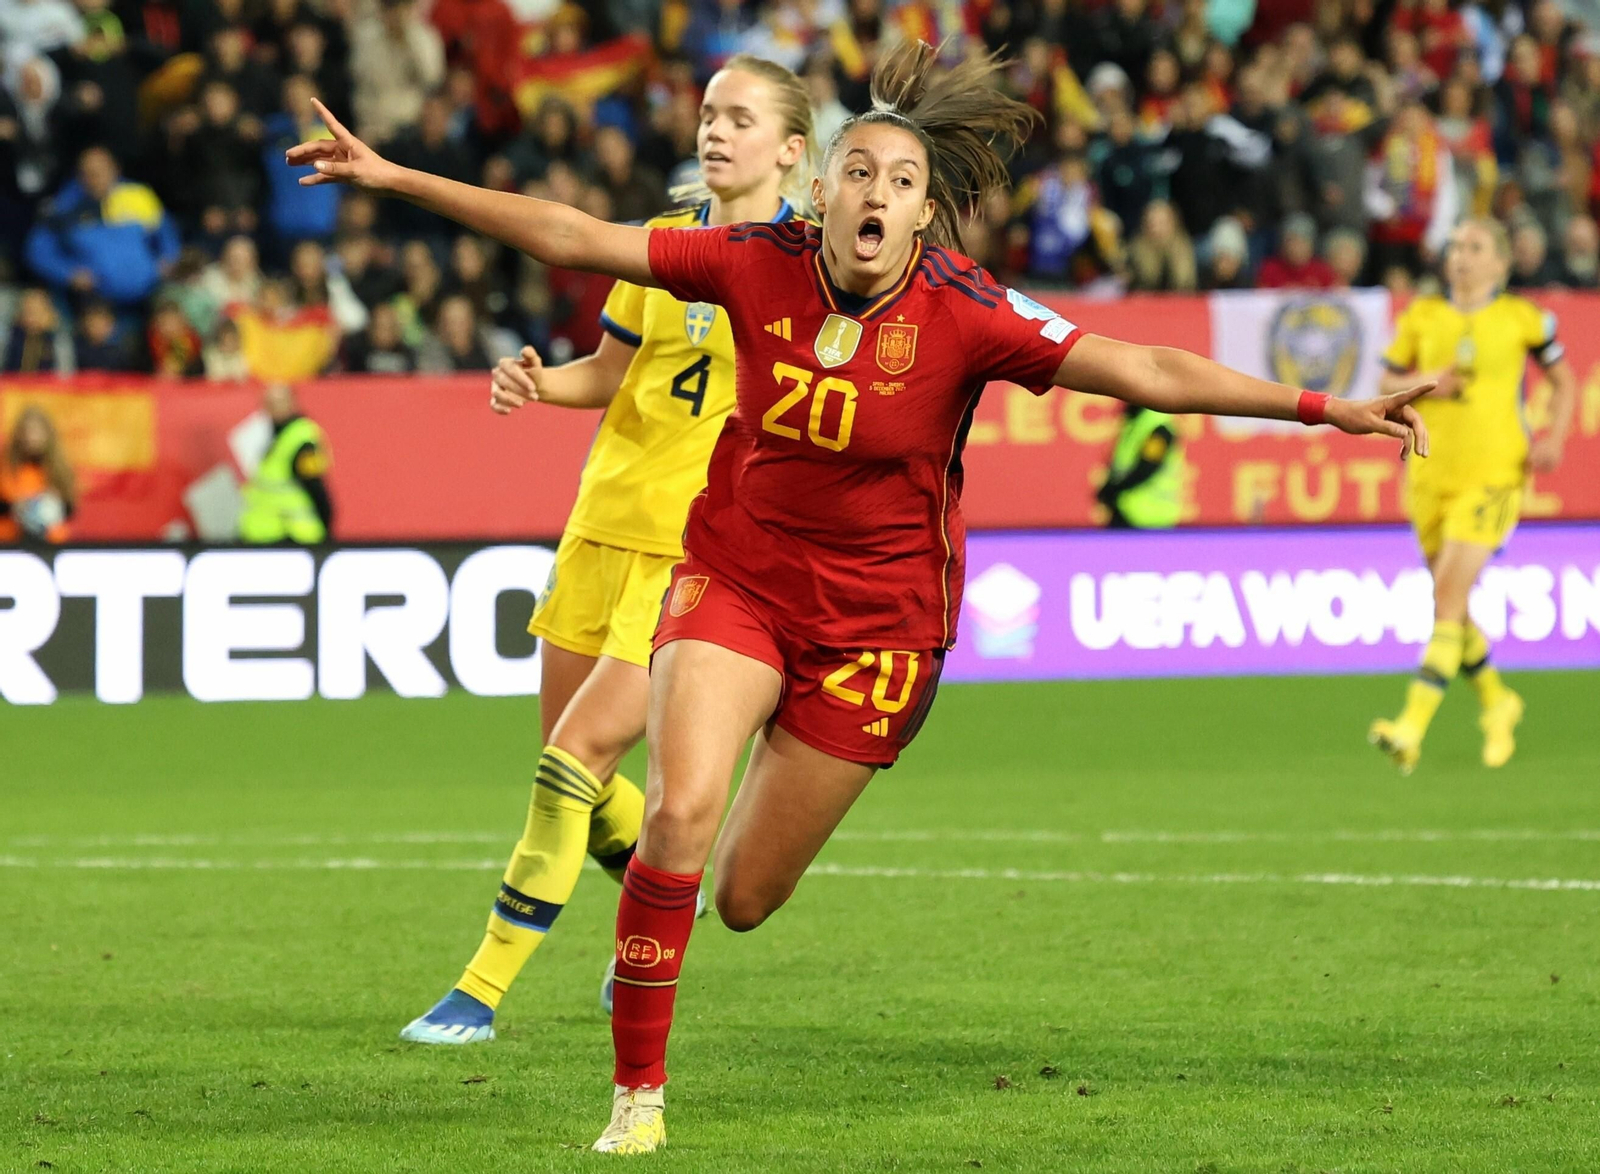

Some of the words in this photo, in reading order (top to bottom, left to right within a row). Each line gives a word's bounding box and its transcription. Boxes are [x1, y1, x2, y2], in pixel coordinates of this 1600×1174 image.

[671, 354, 712, 418] 4
[762, 361, 859, 453] 20
[1070, 571, 1246, 650] UEFA
[821, 650, 919, 714] 20
[663, 948, 676, 960] 09
